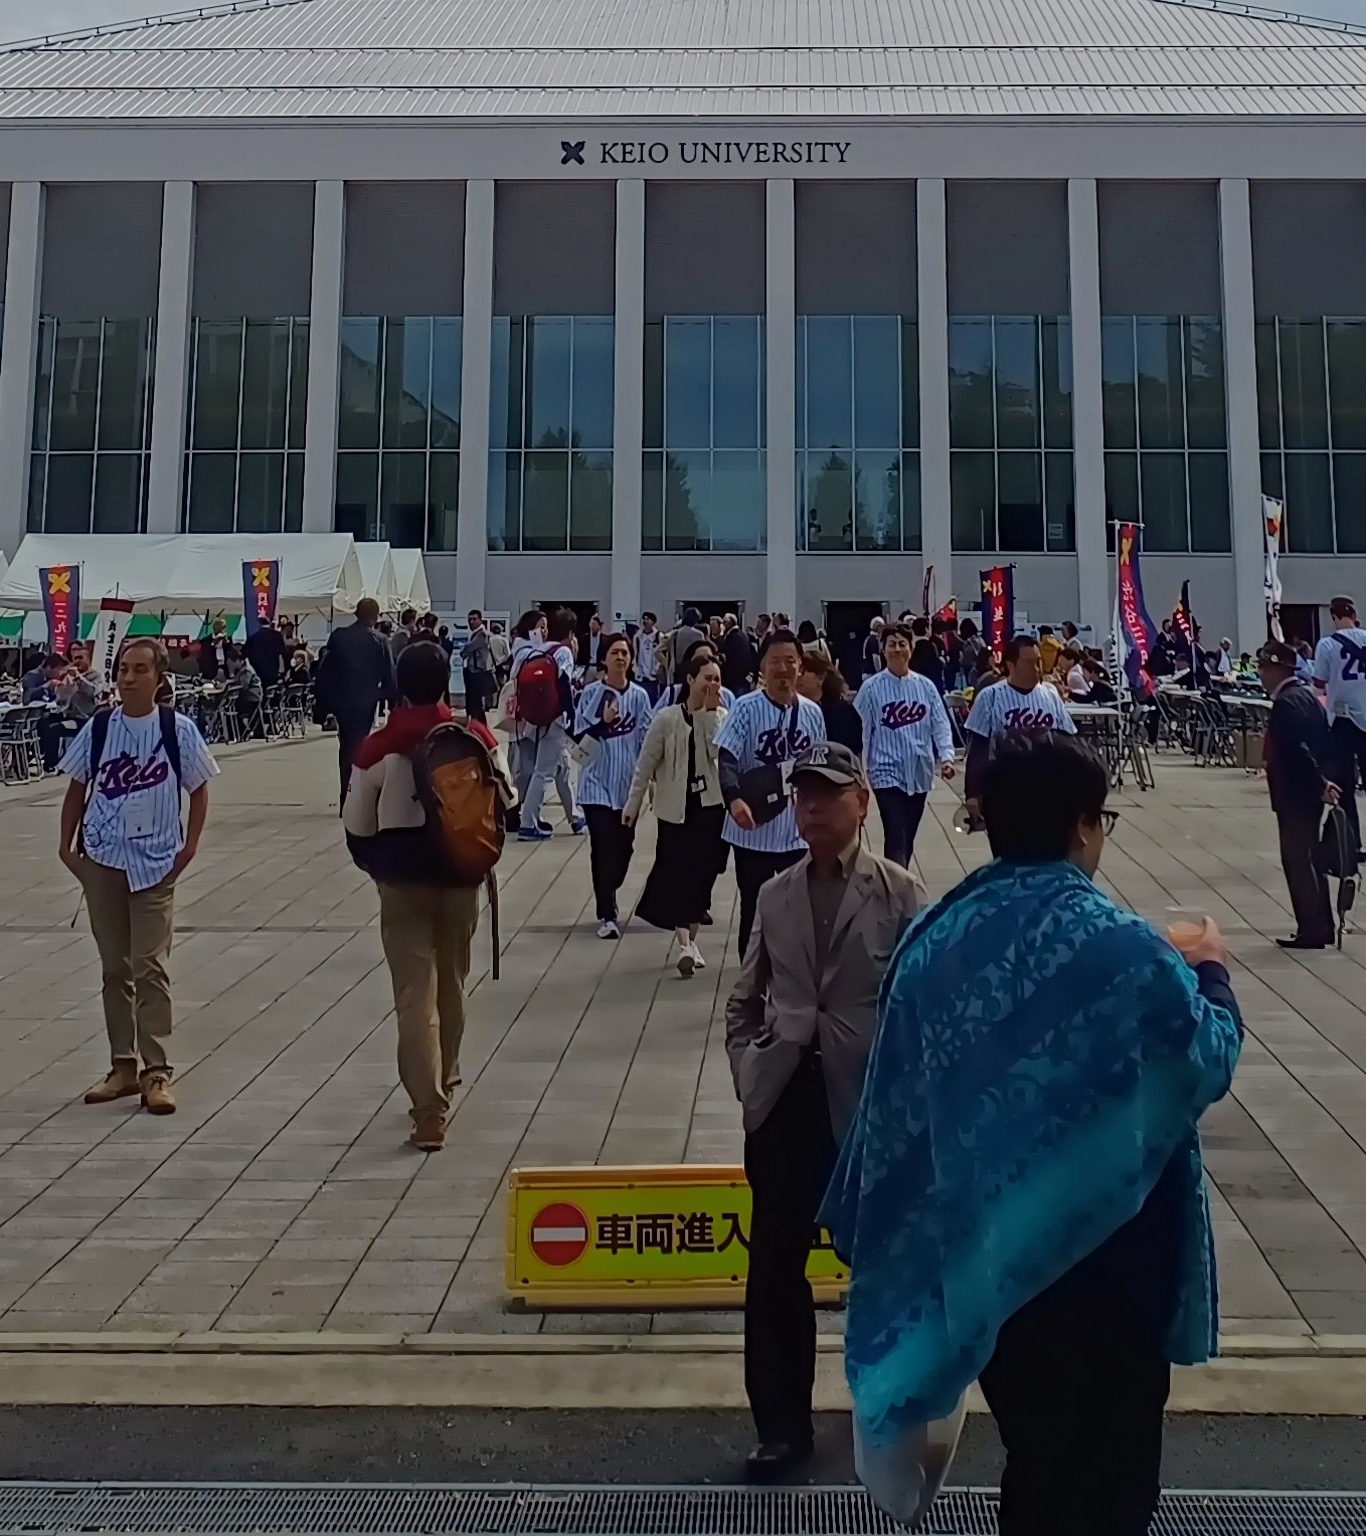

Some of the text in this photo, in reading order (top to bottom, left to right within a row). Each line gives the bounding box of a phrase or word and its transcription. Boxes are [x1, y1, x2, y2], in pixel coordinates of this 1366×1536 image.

[599, 141, 852, 164] KEIO UNIVERSITY
[880, 700, 927, 729] Keio
[98, 751, 169, 796] Keio
